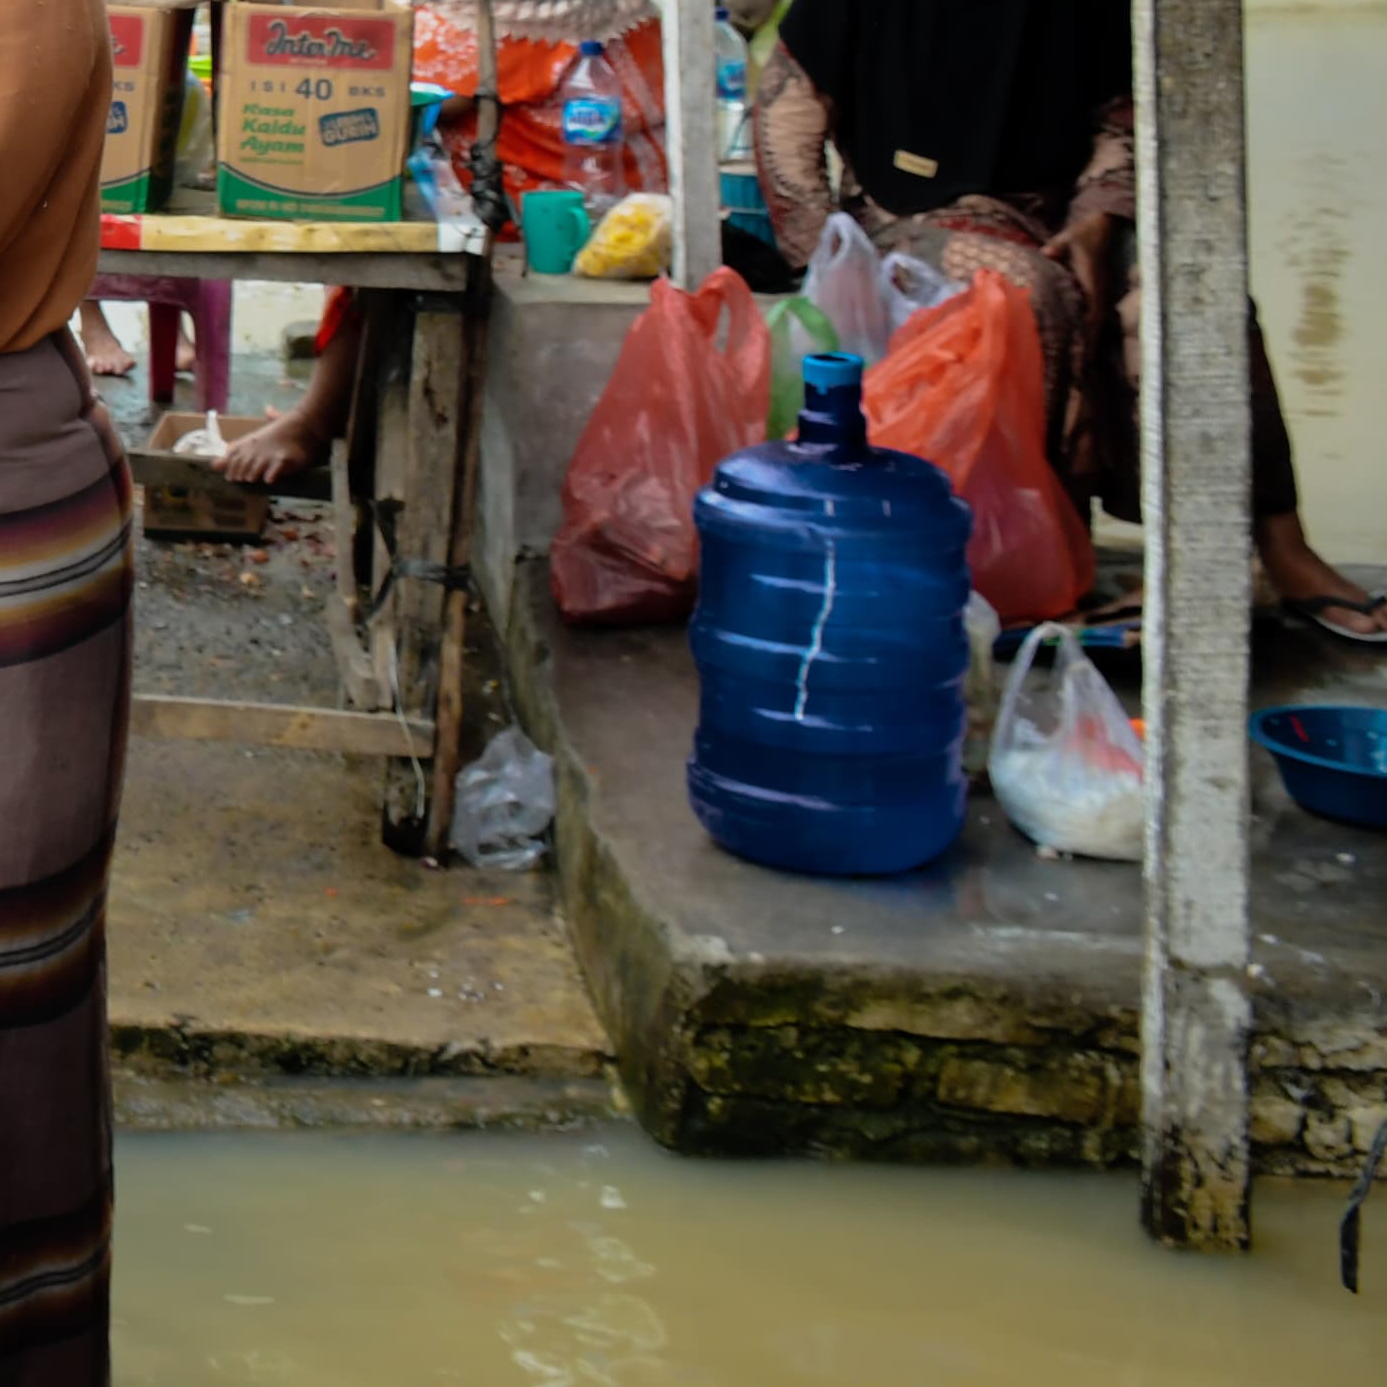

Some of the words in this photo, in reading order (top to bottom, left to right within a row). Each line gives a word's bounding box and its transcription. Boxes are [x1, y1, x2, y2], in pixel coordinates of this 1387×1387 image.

[294, 77, 334, 102] 40
[347, 85, 386, 99] BKS
[242, 118, 307, 136] Kaldu
[239, 135, 306, 156] Ayam
